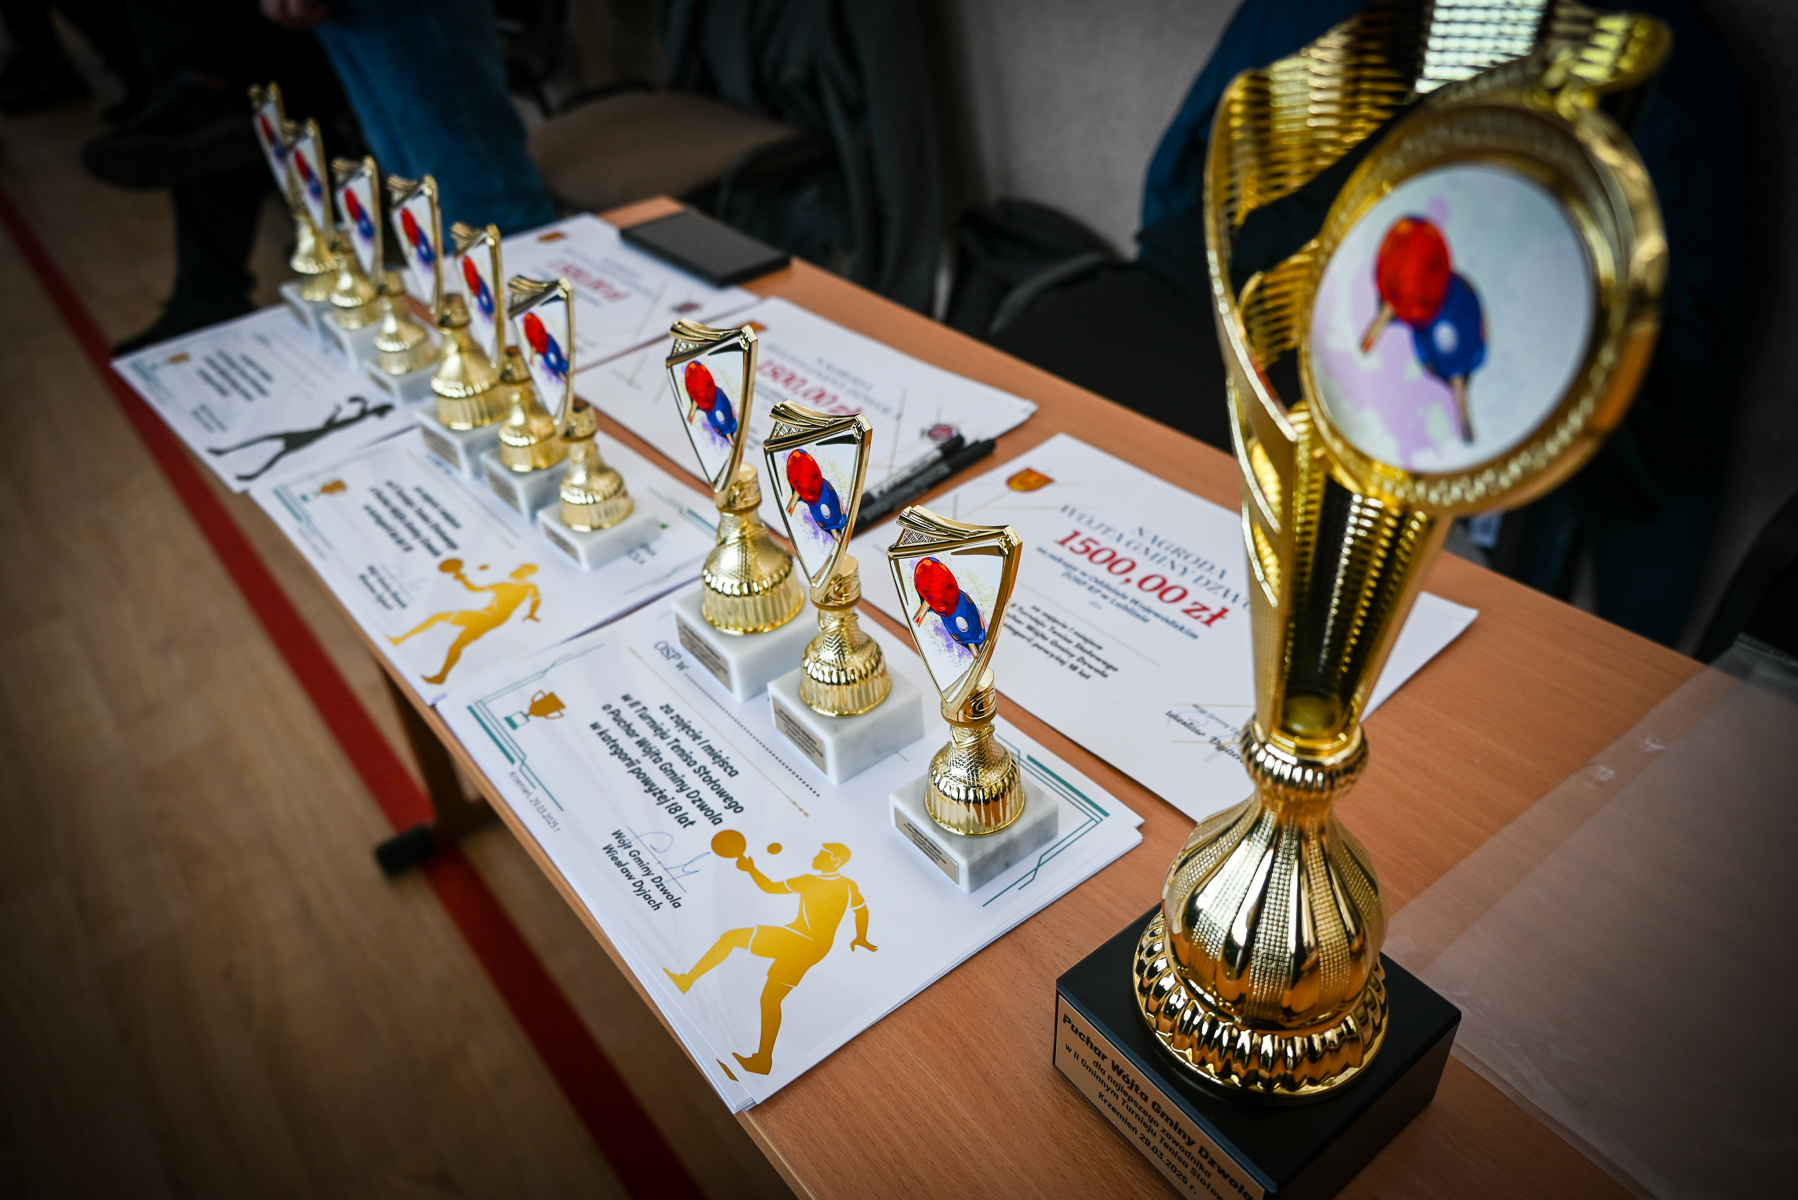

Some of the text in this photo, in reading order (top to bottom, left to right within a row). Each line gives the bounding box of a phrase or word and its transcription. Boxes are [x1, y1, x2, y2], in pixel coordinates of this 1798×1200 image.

[1053, 530, 1230, 628] 1500,00 zł
[1131, 525, 1227, 580] NAGRODA
[654, 640, 682, 661] OSP
[589, 721, 697, 829] w kategorii powyżej 18 lat
[602, 703, 724, 826] o Puchar Wójta Gminy Dzwola
[621, 693, 633, 702] w
[634, 705, 671, 741] Turnieju
[666, 738, 698, 768] Tenisa
[693, 765, 744, 814] Stołowego
[659, 703, 675, 715] za
[669, 713, 703, 742] zajęcie
[701, 744, 739, 778] miejsca
[602, 843, 664, 912] Wiesław Dyjach
[611, 829, 682, 909] Wójt Gminy Dzwola
[1063, 1013, 1108, 1061] Puchar
[1111, 1060, 1149, 1103] Wójta
[1151, 1101, 1197, 1147] Gminy
[1065, 1043, 1073, 1053] w
[1080, 1058, 1119, 1100] Gminnym
[1121, 1098, 1157, 1137] Turnieju
[1159, 1134, 1189, 1169] Tenisa
[1093, 1060, 1212, 1178] dla najlepszego zawodnika
[1098, 1091, 1138, 1135] Krzemień
[1189, 1184, 1197, 1194] r.
